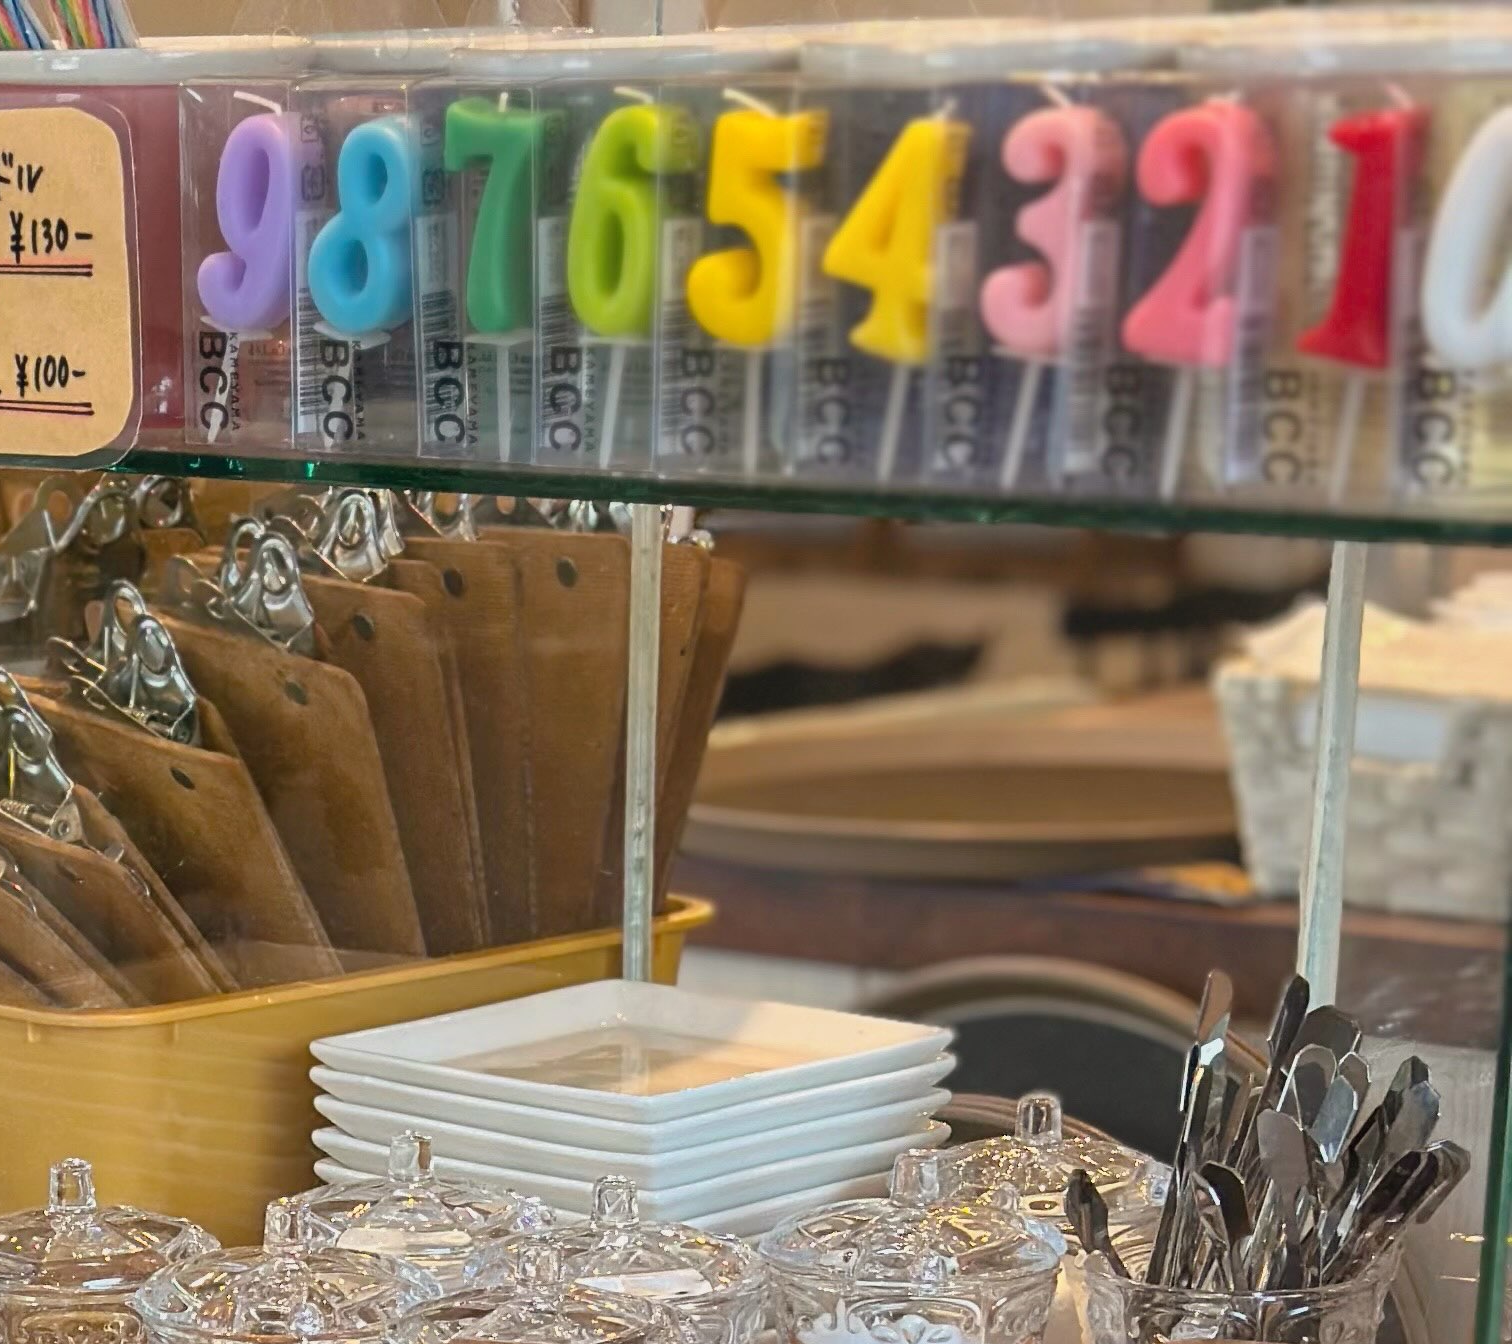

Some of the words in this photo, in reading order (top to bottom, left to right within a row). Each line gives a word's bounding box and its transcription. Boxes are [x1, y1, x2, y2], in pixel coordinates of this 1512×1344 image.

[199, 332, 229, 430] BCC
[229, 332, 241, 431] KAMEYAMA
[320, 339, 353, 440] BCC
[433, 341, 466, 443] BCC
[549, 346, 582, 450] BCC
[681, 350, 715, 456] BCC
[816, 358, 849, 464] BCC
[1263, 370, 1303, 484] BCC
[1412, 370, 1456, 484] BCC
